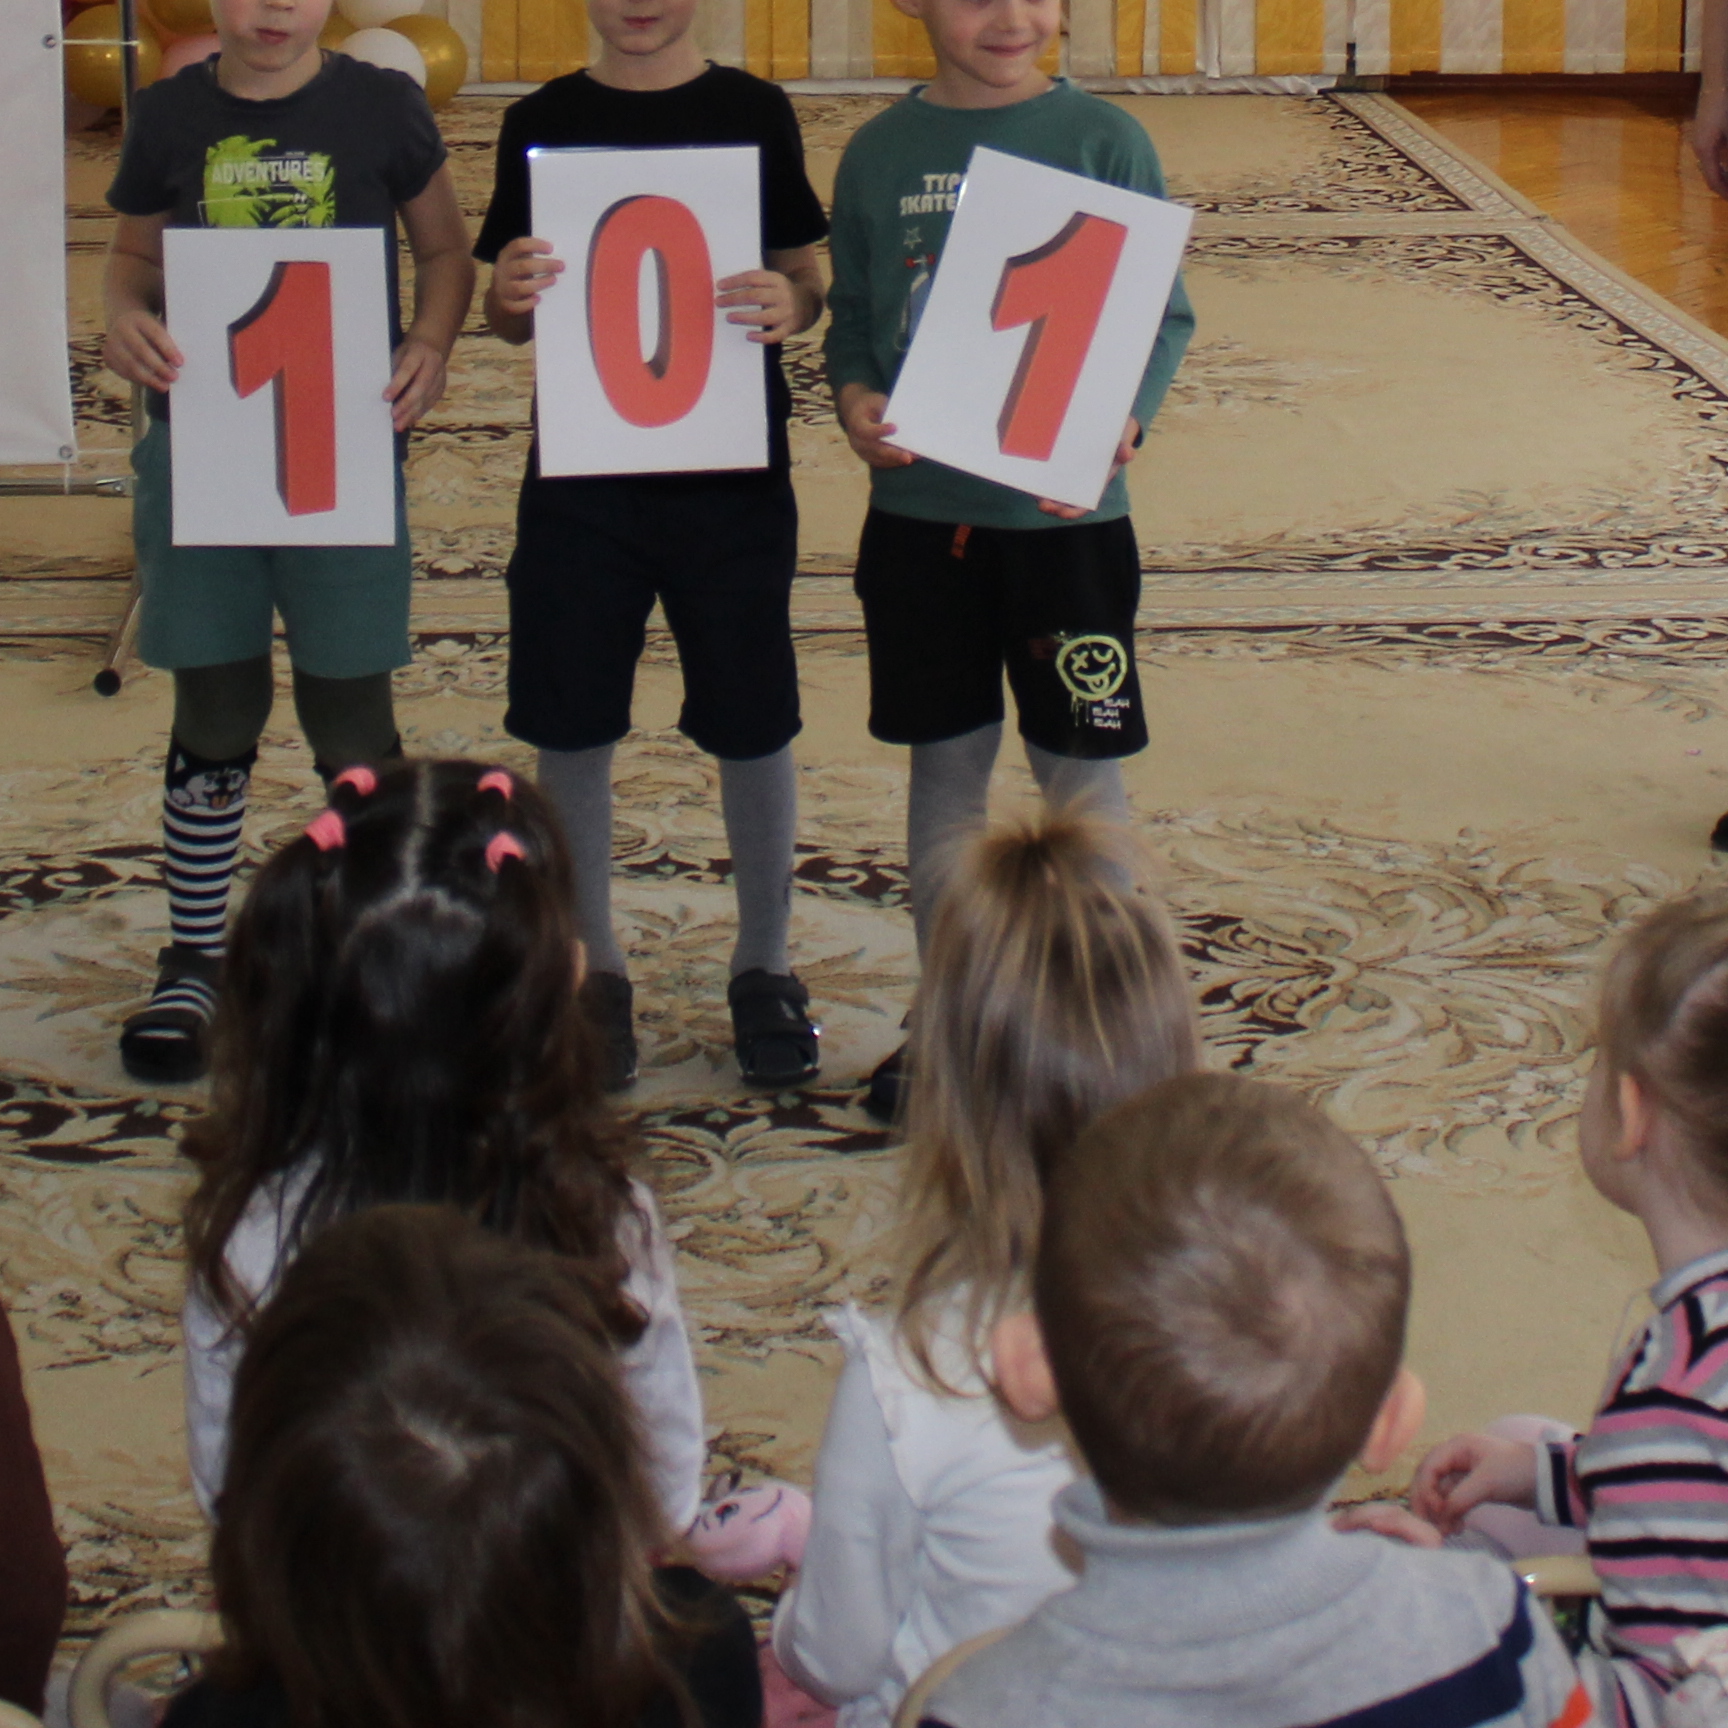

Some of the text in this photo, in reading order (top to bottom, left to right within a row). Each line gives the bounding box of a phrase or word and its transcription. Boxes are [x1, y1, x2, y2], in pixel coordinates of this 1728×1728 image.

[211, 159, 328, 185] ADVENTURES
[922, 173, 962, 193] TYP
[227, 260, 336, 516] 1
[585, 193, 716, 429] 0
[989, 211, 1129, 462] 1
